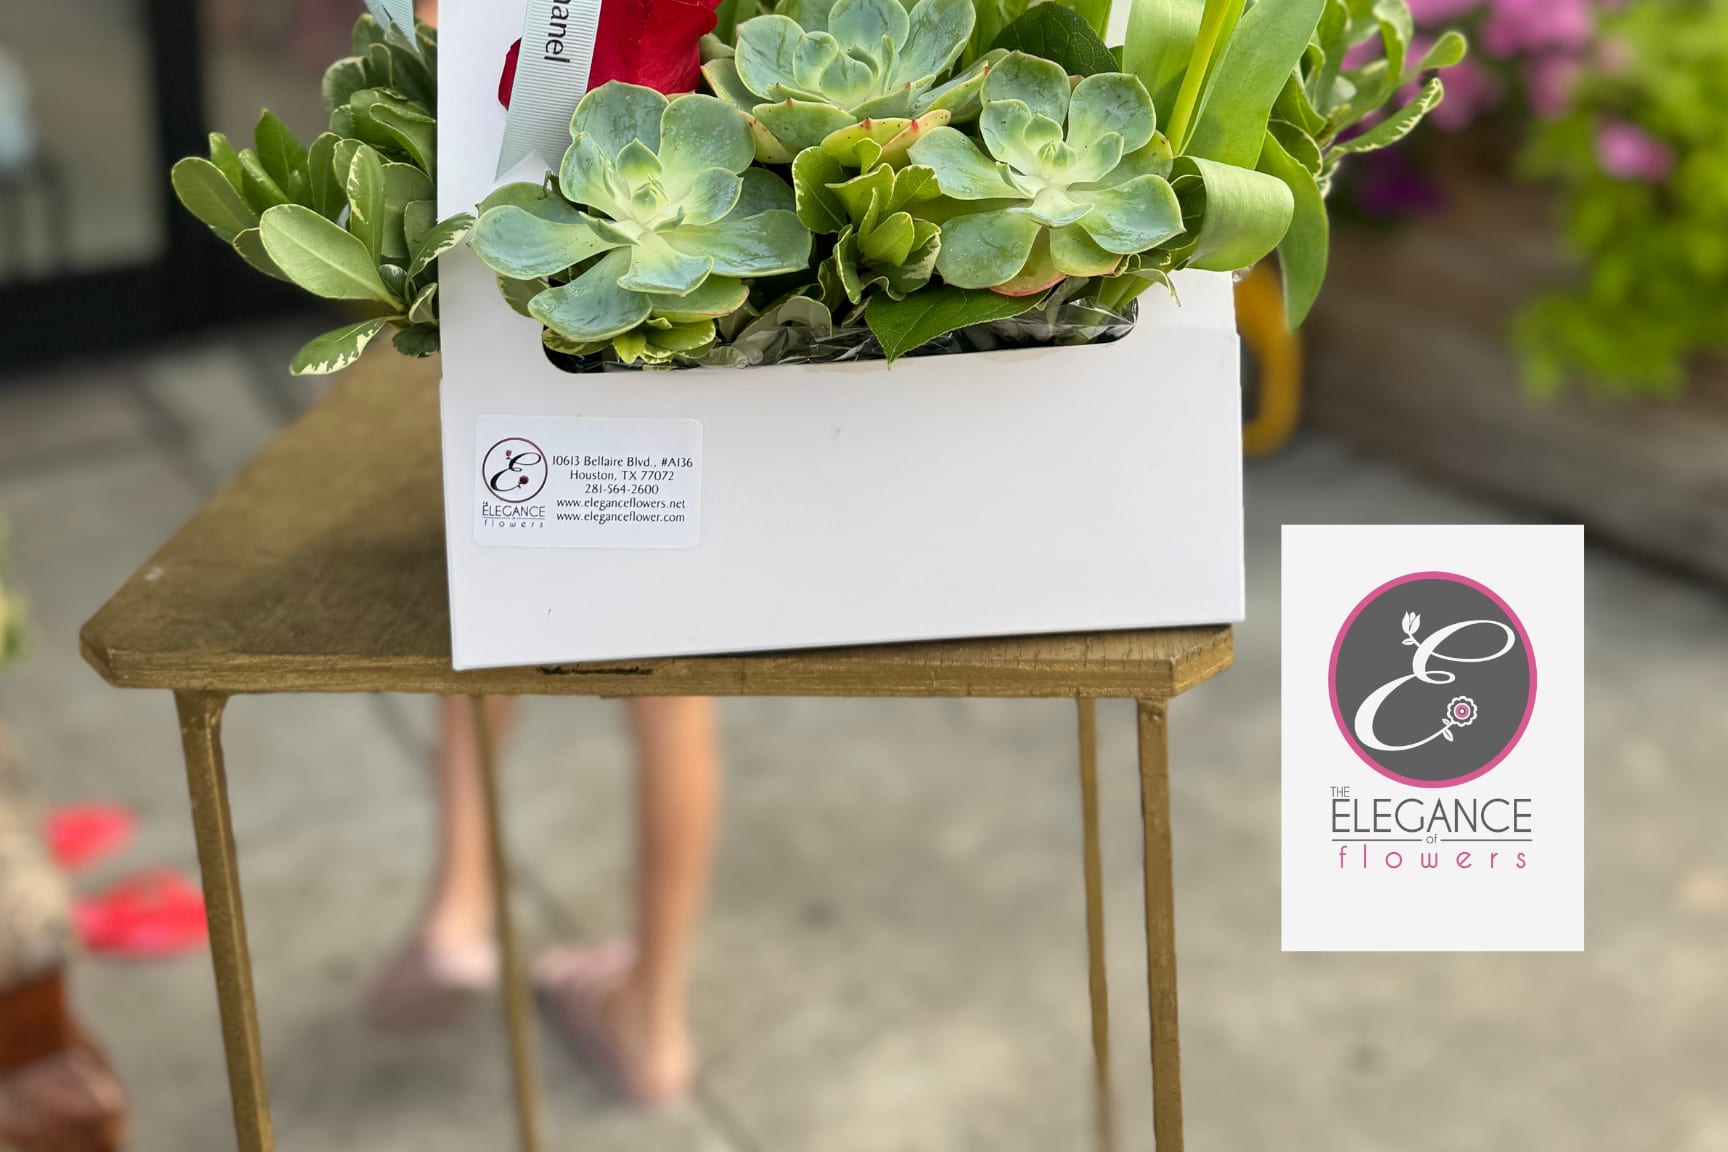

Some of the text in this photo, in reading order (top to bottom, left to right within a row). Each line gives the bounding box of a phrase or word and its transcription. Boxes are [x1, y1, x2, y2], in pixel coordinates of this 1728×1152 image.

[552, 455, 694, 468] 10613 Bellaire Blvd., #A136
[570, 469, 674, 481] Houston, TX 77072
[585, 483, 659, 495] 281-564-2600
[556, 497, 686, 511] www.eleganceflowers.net
[482, 505, 546, 517] ELEGANCE
[484, 519, 544, 528] flowers
[556, 511, 686, 525] www.eleganceflower.com
